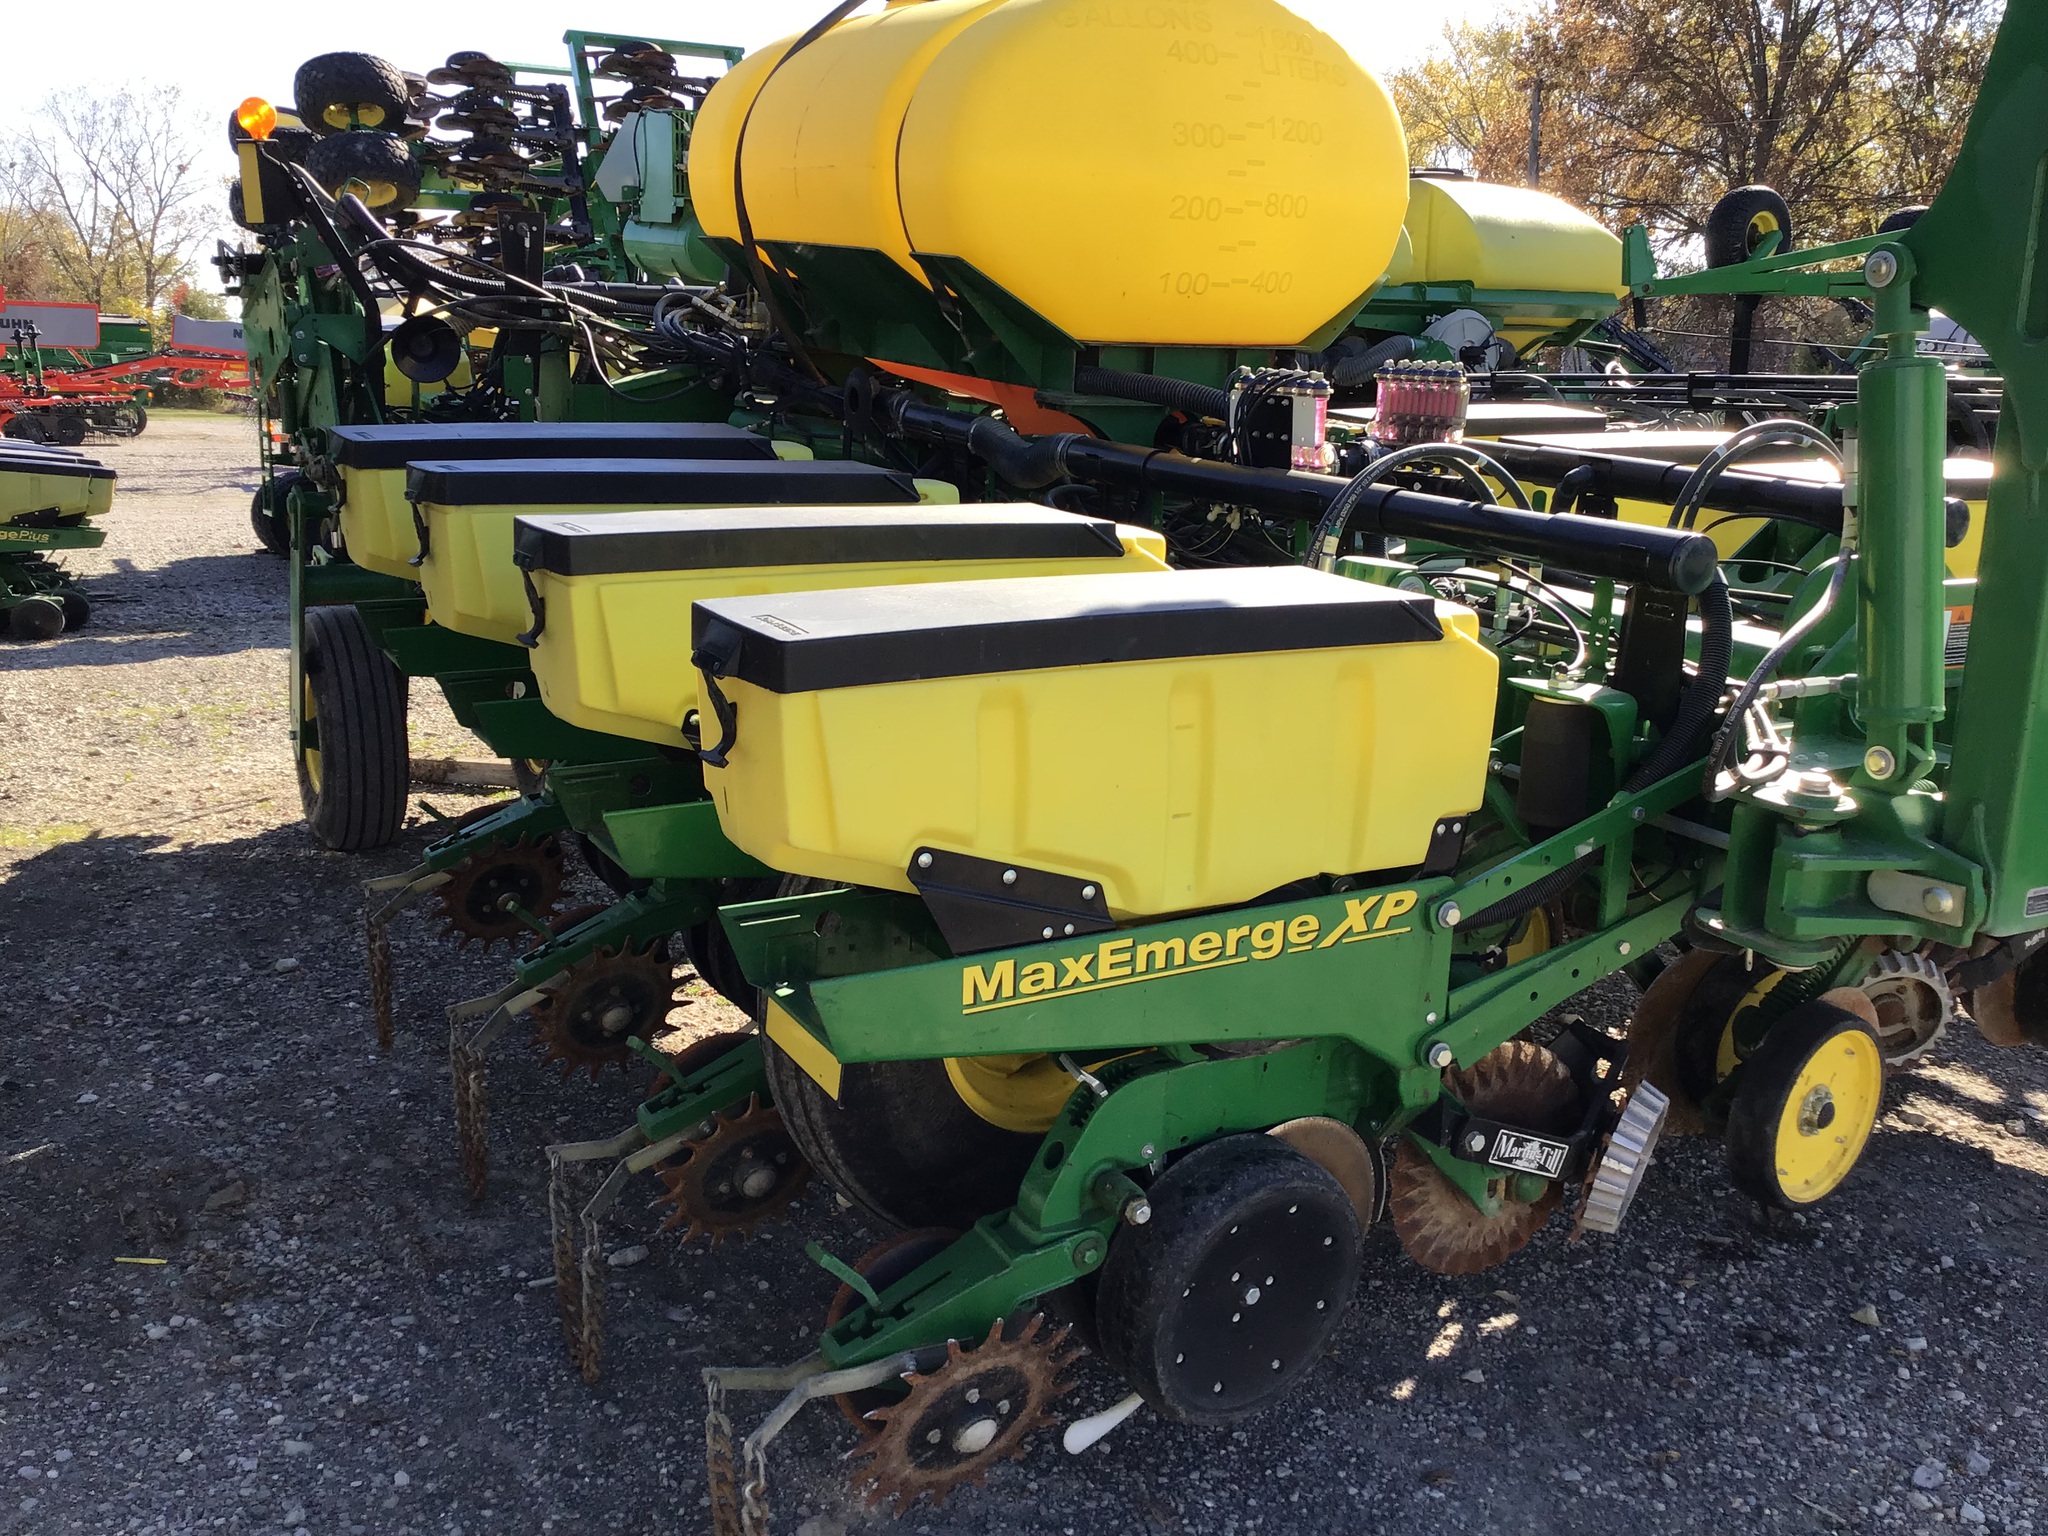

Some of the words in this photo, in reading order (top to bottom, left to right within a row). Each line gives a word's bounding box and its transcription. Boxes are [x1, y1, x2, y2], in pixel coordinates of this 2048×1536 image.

[1055, 6, 1213, 33] GALLONS
[1166, 40, 1219, 66] 400
[1259, 51, 1348, 87] LITERS
[1172, 121, 1226, 149] 300
[1266, 115, 1323, 146] 1200
[1169, 194, 1223, 222] 200
[1264, 192, 1309, 219] 800
[1159, 271, 1210, 296] 100
[1250, 270, 1293, 294] 400
[962, 914, 1320, 1006] MaxEmerge
[1317, 890, 1418, 948] XP
